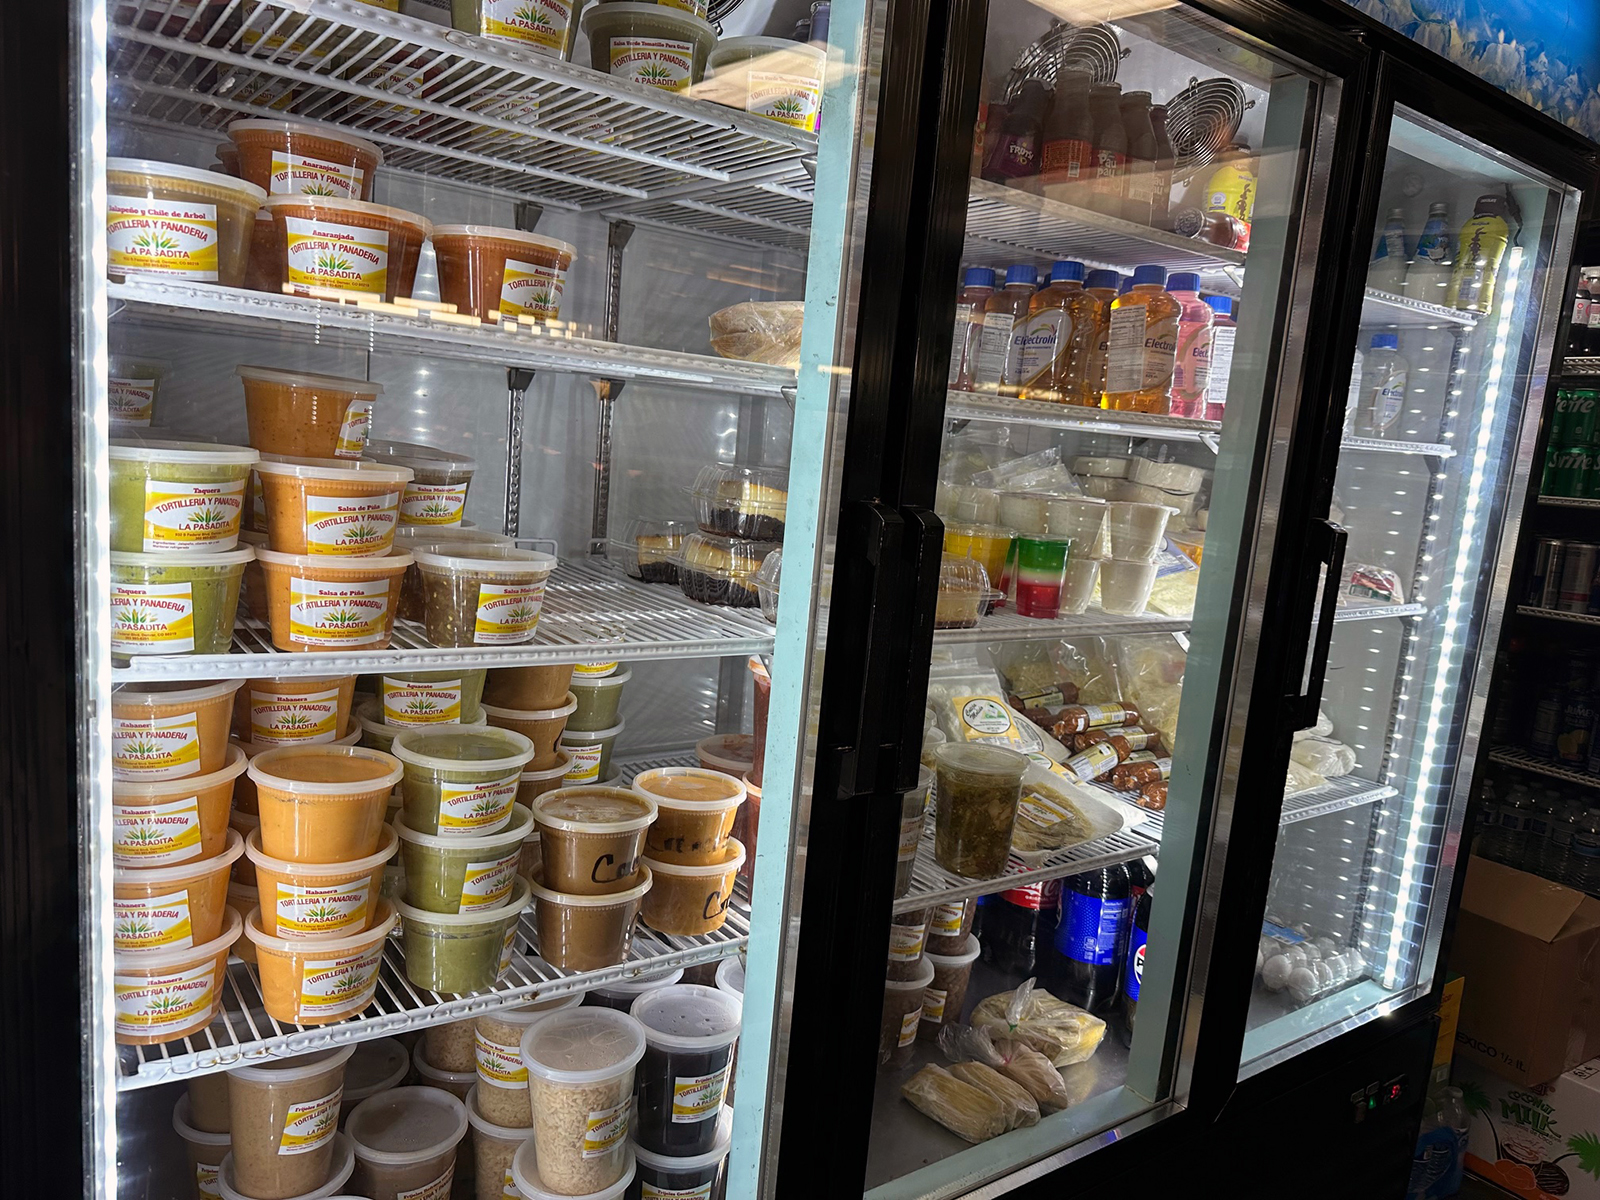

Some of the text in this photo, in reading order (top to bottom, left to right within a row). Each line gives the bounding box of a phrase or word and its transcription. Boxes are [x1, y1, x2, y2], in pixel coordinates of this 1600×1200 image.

[505, 17, 556, 36] LA PASADITA
[613, 52, 690, 72] TORTILLERIA PANADERIA
[642, 77, 677, 87] PASADITA
[777, 111, 806, 120] PASADITA
[302, 160, 340, 173] Anaranjada
[1154, 176, 1164, 186] au
[107, 220, 208, 242] TORTILLERIA PANADERIA
[312, 230, 354, 240] Anaranjada
[125, 247, 190, 259] LA PASADITA
[290, 241, 380, 265] TORTILLERIA PANADERIA
[306, 266, 362, 280] LA PASADITA
[508, 280, 546, 290] TORTILLERIA
[126, 389, 150, 400] PANADERIA
[1548, 452, 1592, 470] Srite
[155, 498, 240, 513] TORTILLERIA PANADERIA
[402, 495, 436, 504] TORTILLERIA
[194, 521, 230, 530] PASADITA
[314, 514, 393, 530] TORTILLERIA PANADERIA
[349, 536, 383, 545] PASADITA
[140, 599, 185, 613] PANADERIA
[350, 600, 382, 610] PANADERIA
[483, 598, 522, 611] TORTILLERIA
[426, 692, 456, 700] PANADERIA
[254, 705, 291, 714] TORTILLERIA
[146, 732, 187, 740] PANADERIA
[129, 752, 172, 760] PASADITA
[447, 793, 486, 806] TORTILLERIA
[475, 806, 505, 818] PASADITA
[130, 837, 174, 846] PASADITA
[471, 867, 505, 886] TORTILLERIA
[280, 895, 361, 907] TORTLLERIA PANADERIA
[309, 913, 347, 923] PASADITA
[121, 930, 164, 939] PASADITA
[147, 977, 182, 985] Habanera
[307, 967, 349, 984] TORTILLERIA
[173, 981, 208, 992] PANADERIA
[337, 978, 368, 994] PASADITA
[151, 1002, 193, 1016] PASADITA
[496, 1053, 523, 1066] PANADERIA
[679, 1084, 710, 1098] TORTILLERIA
[1508, 1090, 1556, 1114] COCONUT
[1498, 1098, 1562, 1138] MILK
